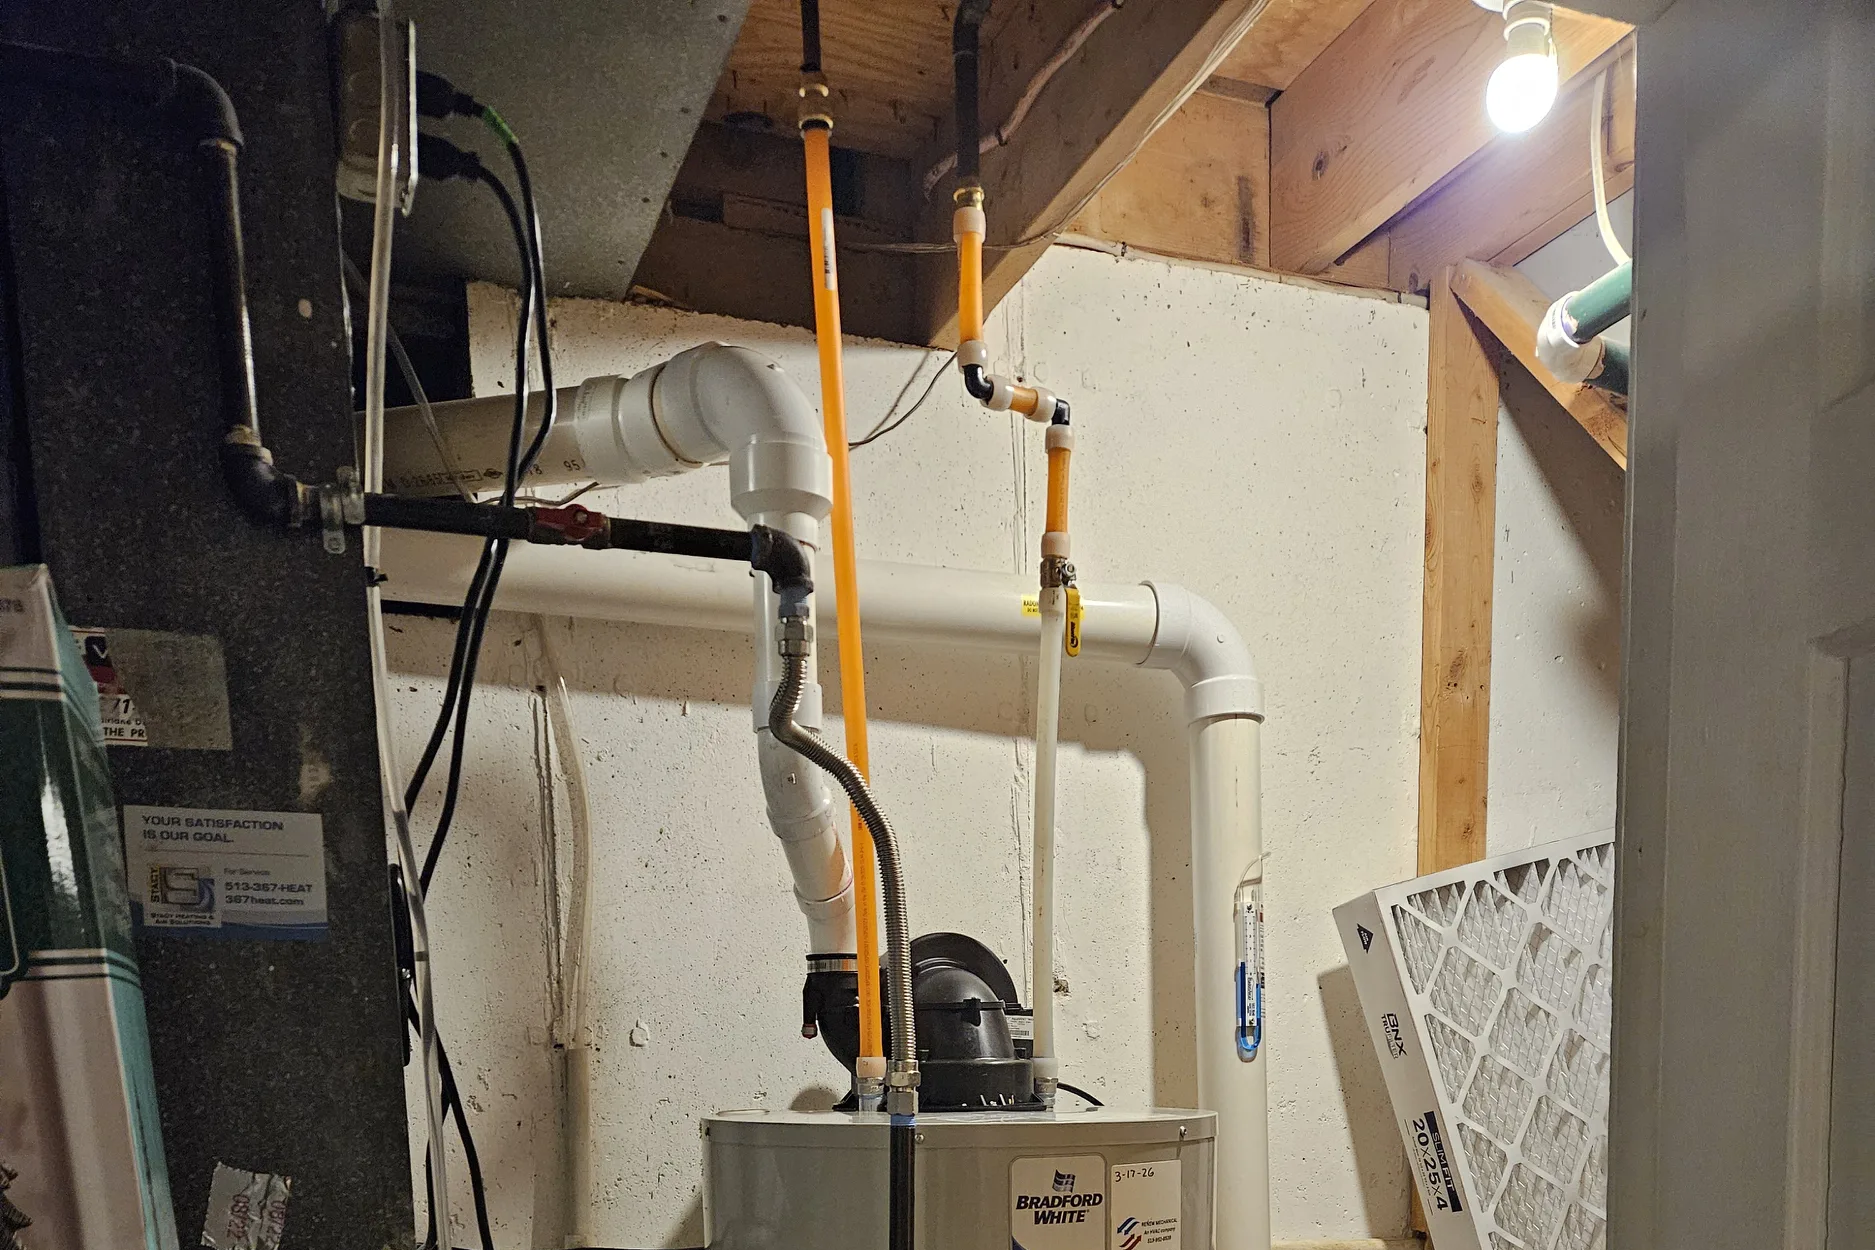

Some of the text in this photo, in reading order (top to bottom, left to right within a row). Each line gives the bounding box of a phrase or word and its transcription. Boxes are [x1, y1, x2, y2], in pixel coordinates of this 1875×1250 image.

[103, 727, 124, 737] THE
[142, 815, 283, 830] YOUR SATISFACTION
[143, 829, 156, 840] IS
[160, 830, 189, 841] OUR
[150, 867, 159, 903] STACY
[1387, 1014, 1408, 1056] BNX
[1431, 1132, 1455, 1191] SLIM FIT
[1115, 1167, 1154, 1183] 3-17-26
[1016, 1193, 1103, 1210] BRADFORD
